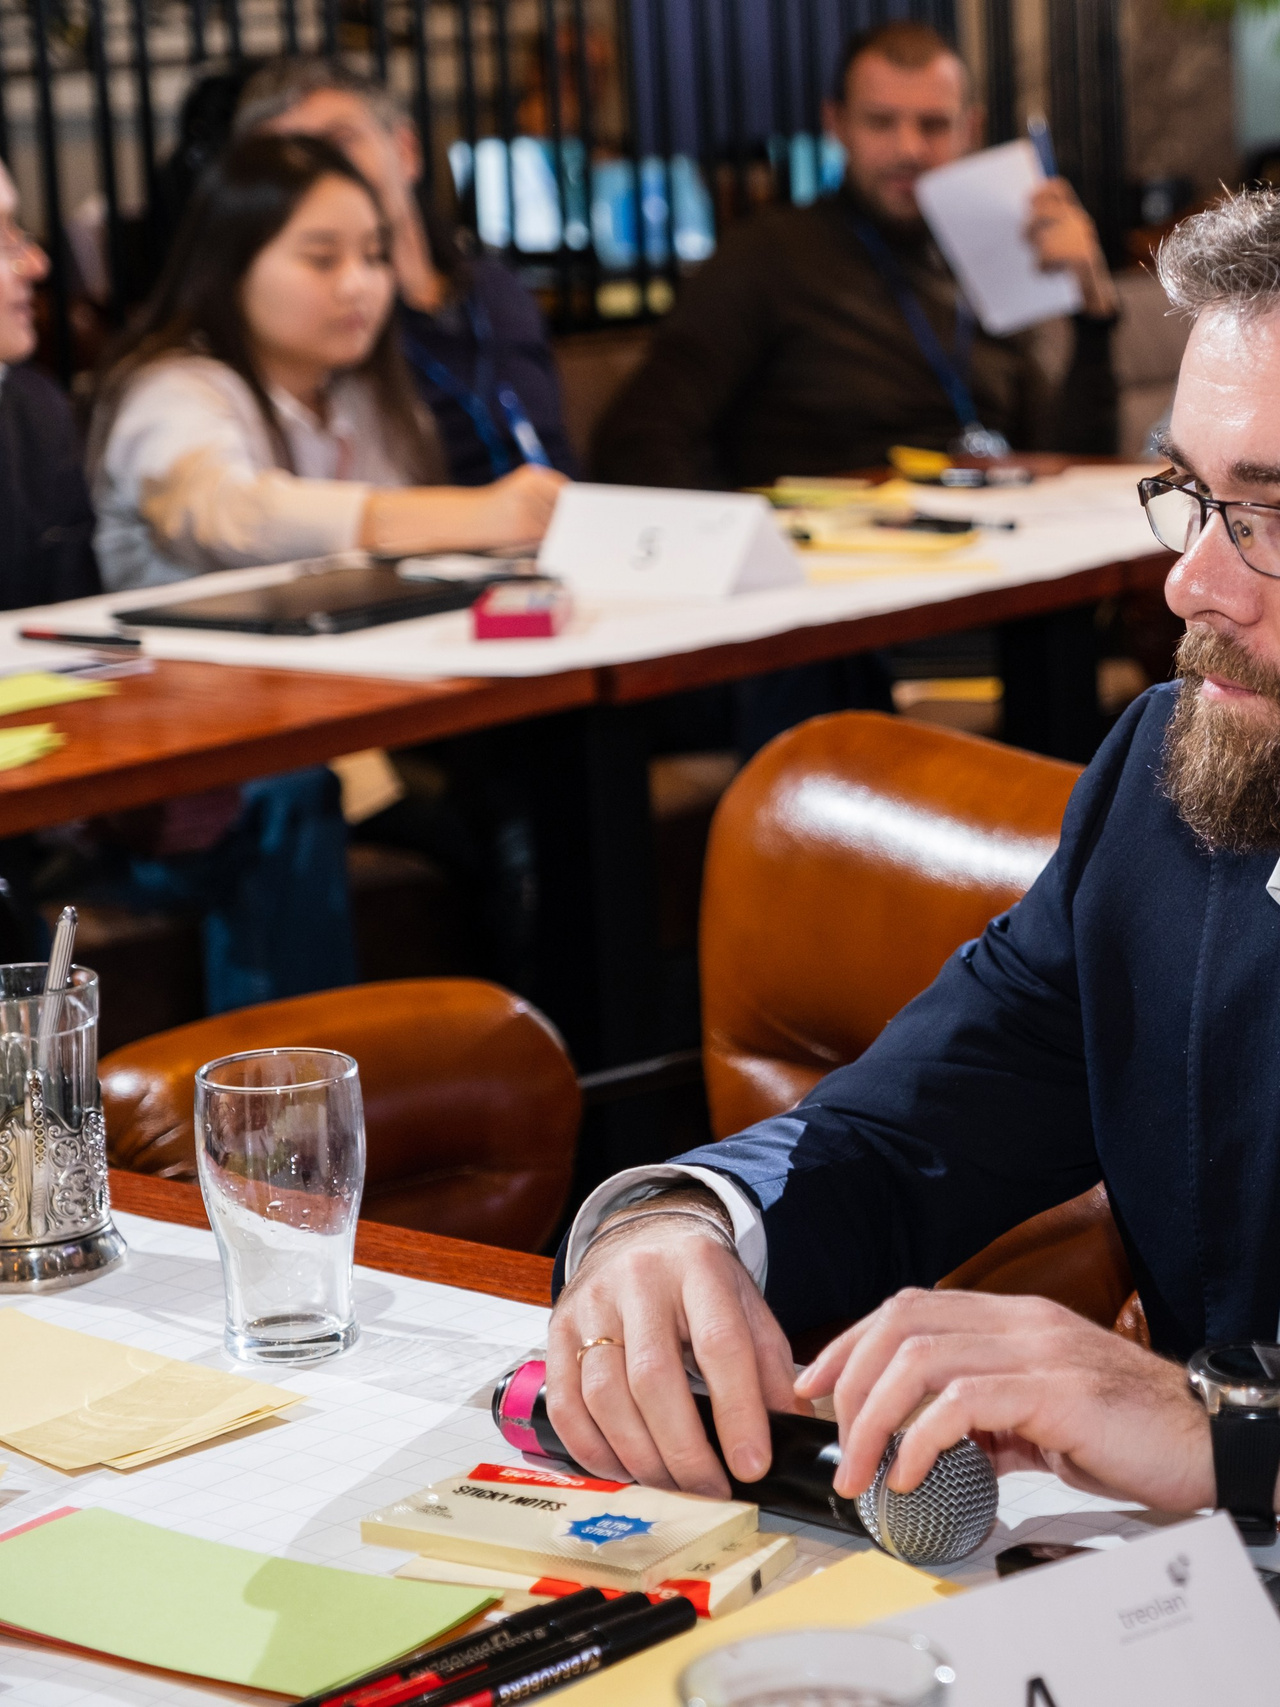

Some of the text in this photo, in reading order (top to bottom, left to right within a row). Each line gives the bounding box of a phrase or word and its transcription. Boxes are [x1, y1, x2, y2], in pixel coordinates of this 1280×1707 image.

[499, 1468, 585, 1486] Berlingo
[452, 1485, 567, 1511] STICKY NOTES
[581, 1520, 633, 1538] ULTRA STICKY
[1118, 1596, 1188, 1630] treolan
[498, 1654, 581, 1706] BRAUBERG
